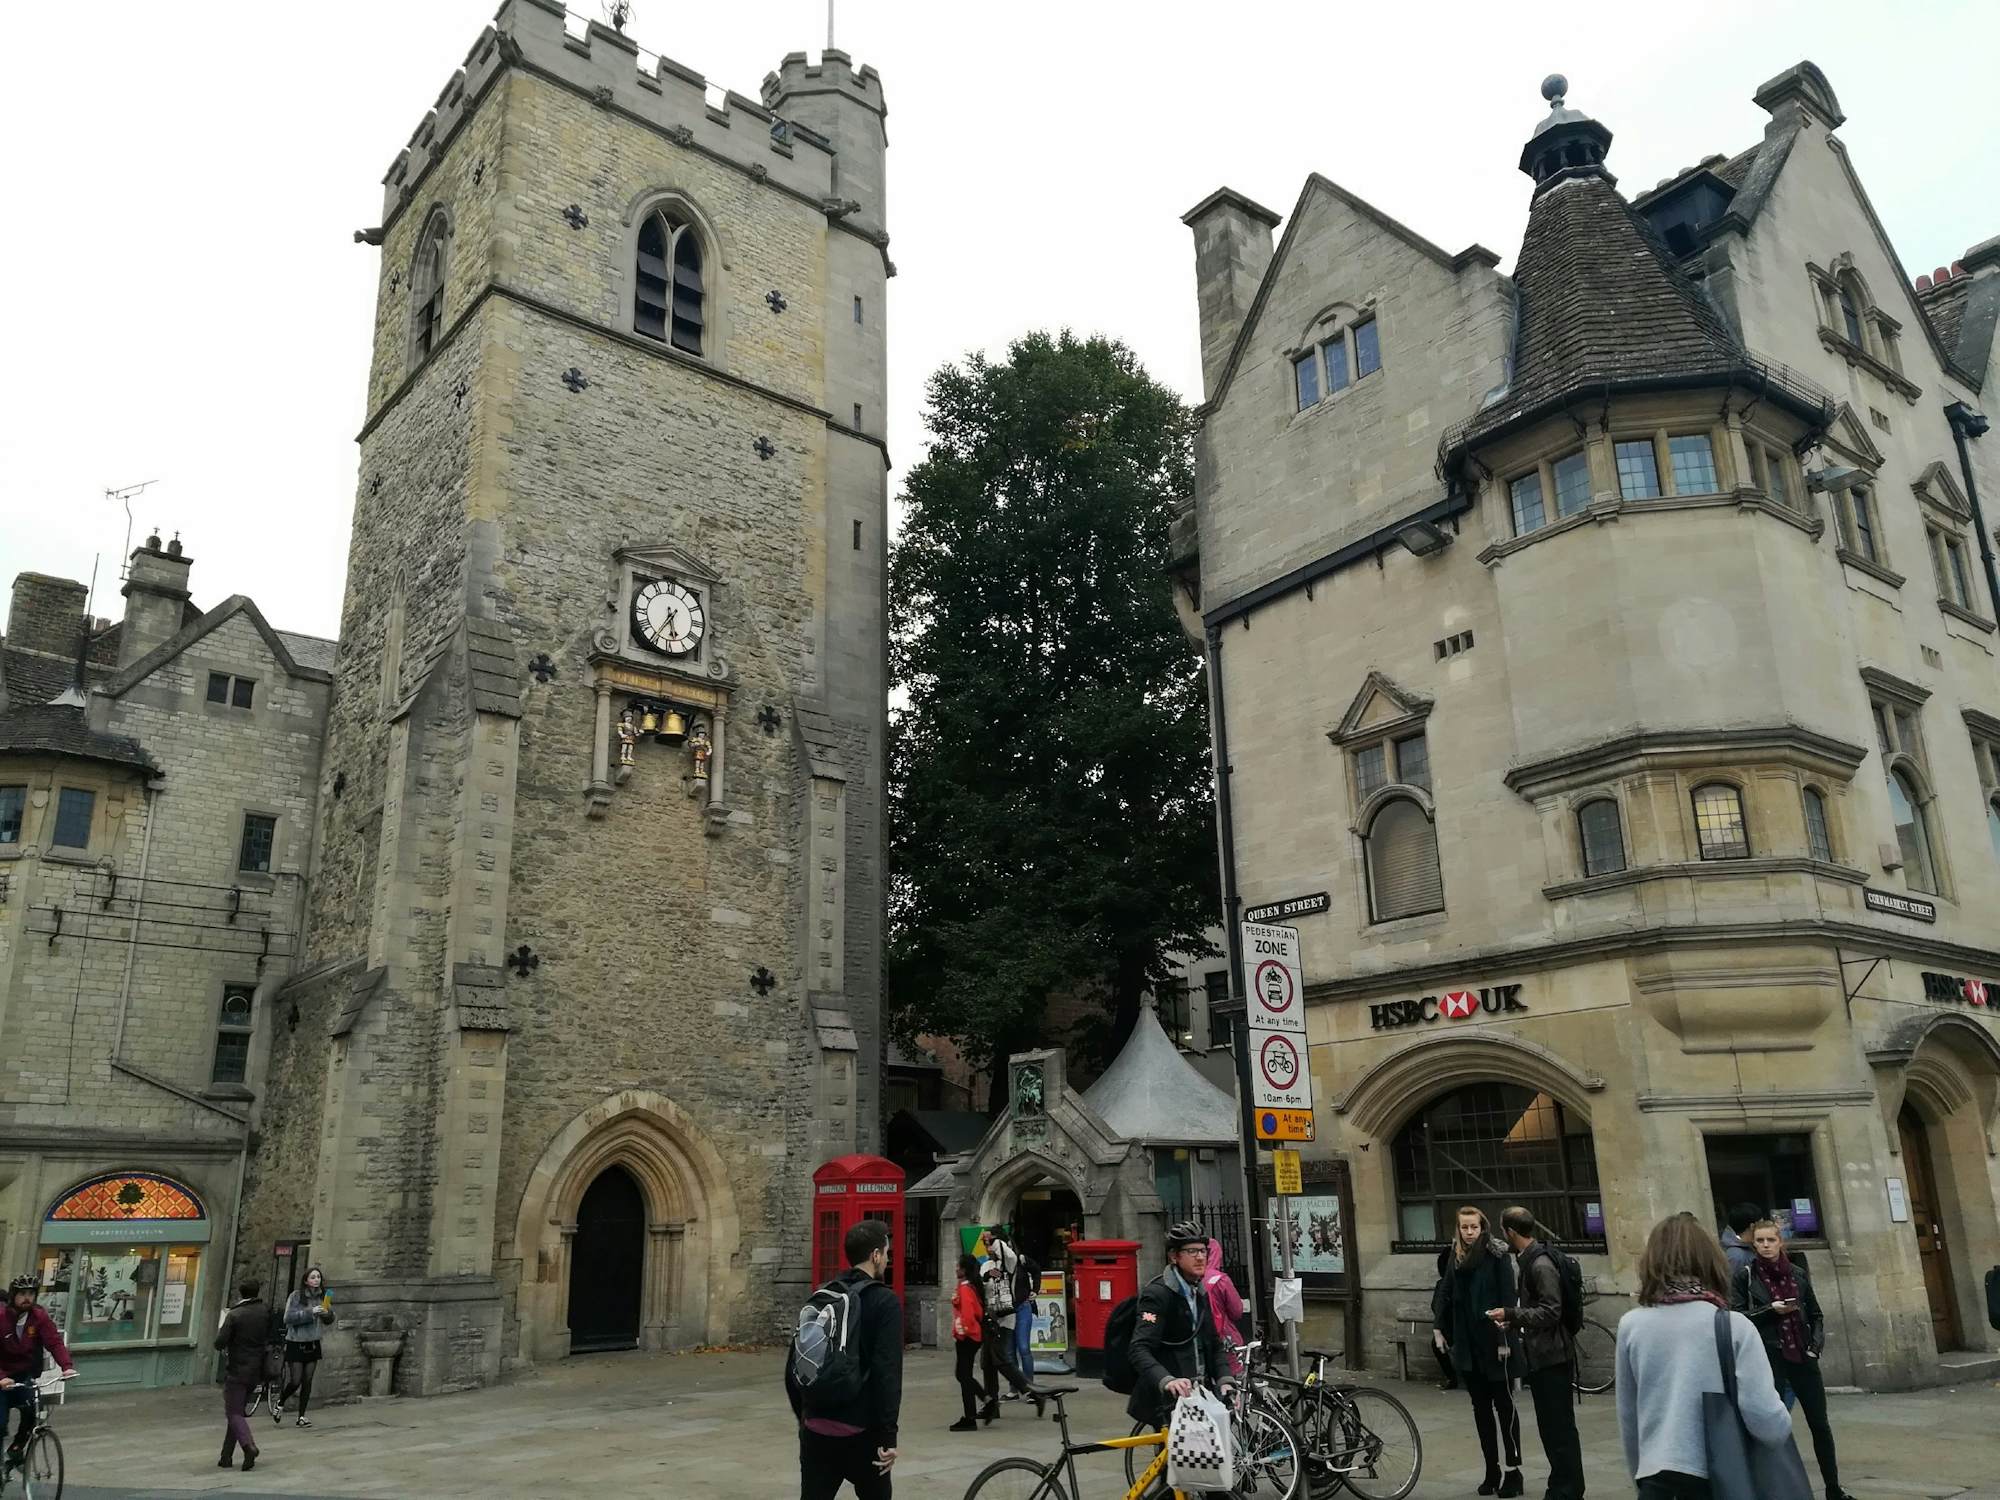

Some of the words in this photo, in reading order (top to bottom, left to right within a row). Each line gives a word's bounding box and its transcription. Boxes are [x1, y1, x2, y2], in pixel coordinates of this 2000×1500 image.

[1247, 905, 1280, 921] QUEEN
[1284, 896, 1325, 913] STREET
[1867, 892, 1909, 912] CORNMARKET
[1910, 902, 1933, 917] STREET
[1245, 926, 1296, 940] PEDESTRIAN
[1255, 940, 1288, 956] ZONE
[1921, 972, 1966, 1002] HSBC
[1368, 996, 1439, 1029] HSBC
[1478, 983, 1528, 1013] UK
[1255, 1014, 1265, 1024] At
[1267, 1017, 1280, 1027] any
[1282, 1016, 1299, 1027] time
[1283, 1113, 1292, 1123] At
[1294, 1115, 1307, 1125] any
[1288, 1124, 1304, 1133] time
[857, 1184, 896, 1193] TELEPHONE
